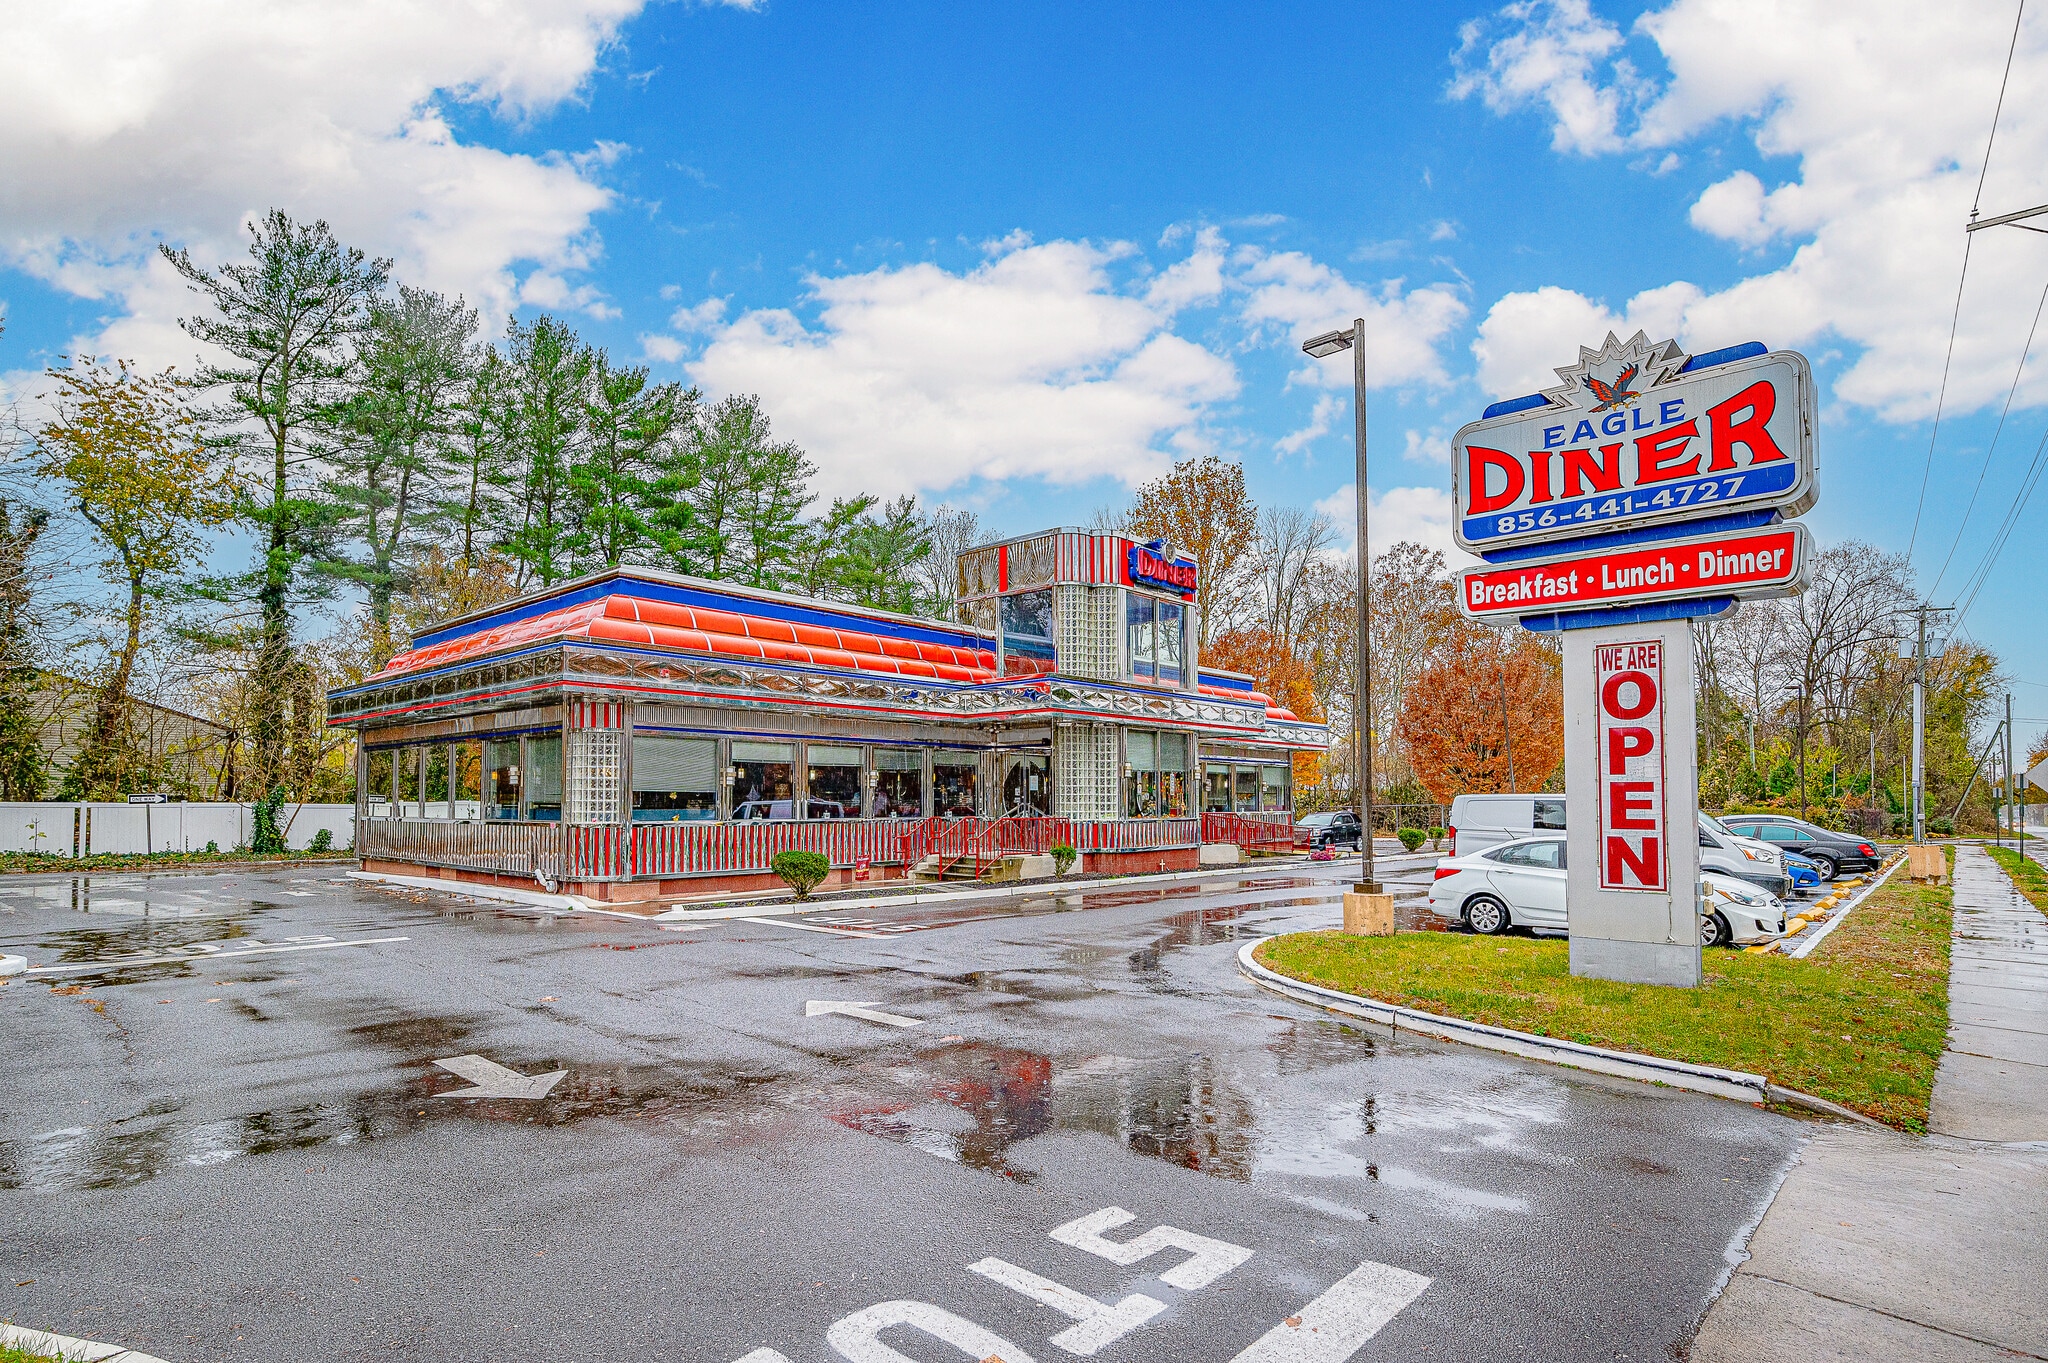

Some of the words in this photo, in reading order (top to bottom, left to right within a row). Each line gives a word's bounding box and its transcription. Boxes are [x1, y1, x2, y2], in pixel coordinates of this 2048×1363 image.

[1466, 380, 1788, 516] DINER
[1543, 398, 1686, 450] EAGLE
[1497, 476, 1746, 535] 856-441-4727
[1138, 549, 1197, 590] DINER
[1471, 568, 1578, 605] Breakfast
[1602, 557, 1675, 591] Lunch
[1698, 547, 1785, 578] Dinner
[1601, 648, 1623, 671] WE
[1627, 645, 1657, 669] ARE
[1602, 671, 1659, 886] OPEN
[731, 1206, 1254, 1363] STO
